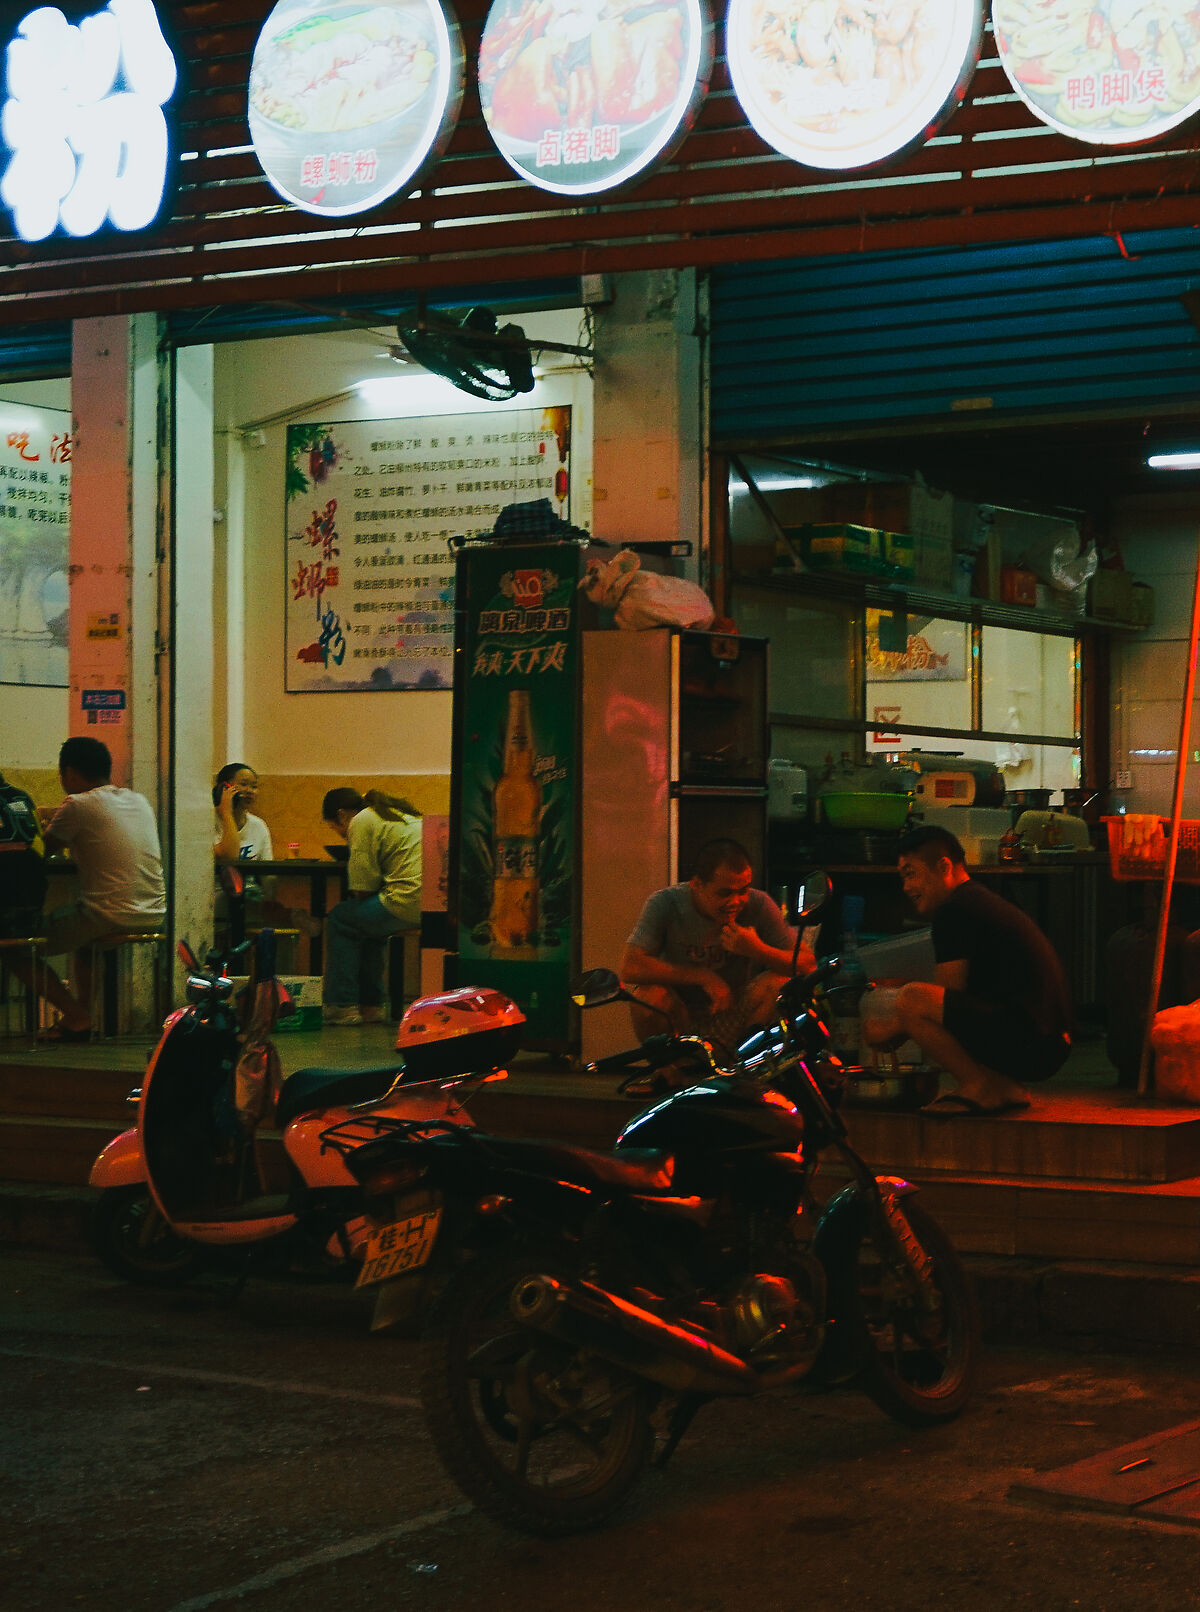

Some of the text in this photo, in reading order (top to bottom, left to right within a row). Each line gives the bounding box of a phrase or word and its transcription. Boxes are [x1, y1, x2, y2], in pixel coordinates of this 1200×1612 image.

[1065, 67, 1168, 110] 鸭脚煲
[535, 123, 621, 168] 卤猪脚
[300, 150, 379, 189] 螺蛳粉
[6, 430, 72, 464] 吃法
